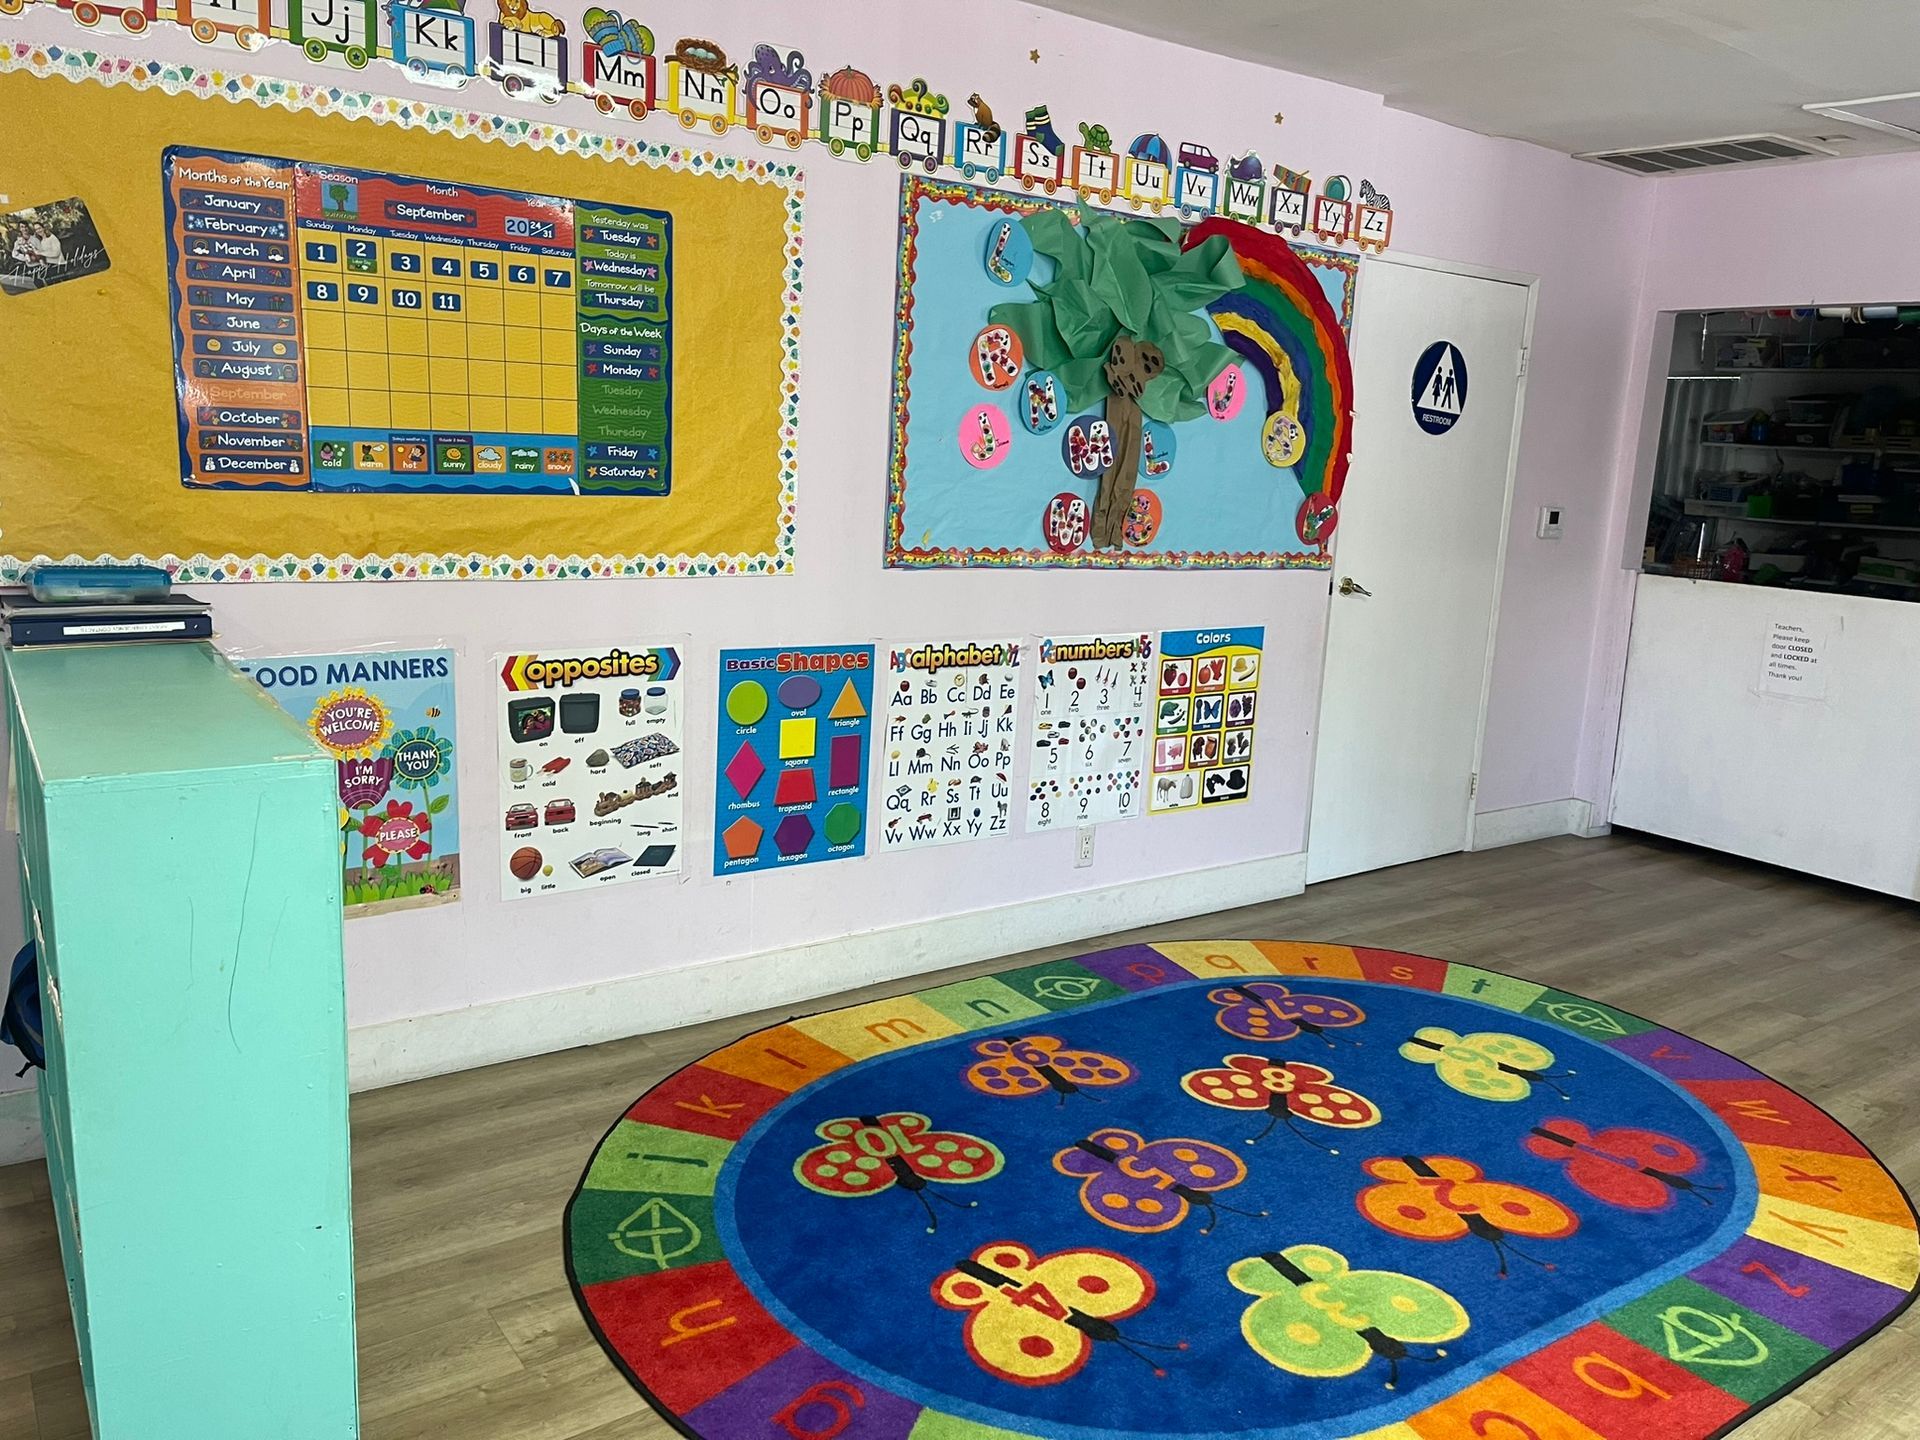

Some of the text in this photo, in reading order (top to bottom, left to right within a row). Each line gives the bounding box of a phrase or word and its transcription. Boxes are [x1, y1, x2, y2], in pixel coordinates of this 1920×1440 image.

[415, 13, 1384, 232] Kk Ll Mm Nn Oo Pp Qq Rr Ss Tt Uu Vv Ww Xx Yy Zz
[179, 167, 290, 191] Months of the Year
[318, 169, 358, 185] Season
[426, 184, 459, 197] Month
[204, 194, 262, 214] January
[396, 204, 465, 223] September
[204, 217, 268, 238] February
[506, 219, 528, 234] 20
[591, 215, 631, 229] Yesterday
[305, 219, 572, 258] Sunday Monday Tuesday Wednesday Thursday Friday Saturday
[600, 230, 641, 246] Tuesday
[215, 241, 259, 257] March
[605, 249, 628, 260] Today
[317, 242, 563, 286] 1 2 3 4 5 6 7
[593, 260, 648, 278] Wednesday
[221, 265, 256, 282] April
[585, 279, 628, 290] Tomorrow
[629, 284, 643, 292] will
[226, 292, 255, 308] May
[316, 285, 455, 309] 8 9 10 11
[596, 293, 644, 309] Thursday
[226, 316, 261, 329] June
[580, 322, 663, 339] Days of the Week
[232, 340, 261, 356] July
[603, 344, 642, 358] Sunday
[221, 362, 273, 379] August
[602, 364, 643, 378] Monday
[209, 386, 288, 400] September
[601, 385, 644, 399] Tuesday
[219, 411, 280, 425] October
[592, 405, 652, 418] Wednesday
[1422, 413, 1452, 426] RESTROOM
[598, 425, 647, 439] Thursday
[217, 433, 286, 447] November
[607, 445, 638, 459] Friday
[217, 457, 288, 470] December
[322, 458, 342, 468] cold
[403, 461, 417, 469] hot
[443, 462, 466, 470] sunny
[477, 461, 502, 470] cloudy
[514, 462, 535, 472] rainy
[547, 463, 572, 472] snowy
[599, 466, 646, 479] Saturday
[1775, 623, 1804, 633] Teachers,
[1196, 632, 1231, 644] Colors
[1773, 633, 1810, 644] Please keep
[1056, 638, 1134, 662] numbers
[1788, 645, 1813, 653] CLOSED
[726, 651, 869, 673] Basic Shapes
[911, 643, 1001, 674] alphabet
[1783, 654, 1809, 662] LOCKED
[326, 657, 449, 684] MANNERS
[526, 650, 659, 687] opposites
[1768, 671, 1786, 679] Thank
[891, 684, 1015, 706] Aa Bb Cc Dd Ee
[327, 707, 373, 721] YOU'RE
[791, 709, 806, 717] oval
[319, 720, 381, 737] WELCOME
[834, 718, 860, 728] triangle
[735, 726, 757, 735] circle
[911, 724, 932, 743] Gg
[397, 749, 437, 762] THANK
[1049, 748, 1058, 763] 5
[406, 759, 430, 771] YOU
[785, 758, 809, 768] square
[908, 760, 933, 775] Mm
[355, 766, 373, 775] I'M
[344, 776, 383, 788] SORRY
[542, 780, 556, 788] cold
[828, 786, 859, 796] rectangle
[728, 800, 760, 810] rhombus
[886, 795, 911, 812] Qq
[1119, 792, 1130, 808] 10
[778, 803, 813, 813] trapezoid
[589, 817, 622, 826] beginning
[379, 828, 417, 842] PLEASE
[909, 825, 937, 841] Ww
[827, 844, 855, 854] octagon
[724, 856, 759, 868] pentagon
[777, 852, 808, 862] hexagon
[600, 874, 616, 882] open
[631, 868, 651, 877] closed
[520, 886, 532, 894] big
[966, 999, 1011, 1017] n
[865, 1016, 927, 1044] m
[674, 1093, 746, 1119] k
[853, 1124, 924, 1157] 10
[1118, 1155, 1176, 1190] 5
[1779, 1163, 1843, 1192] x
[1000, 1282, 1068, 1321] 4
[1302, 1283, 1371, 1328] 3
[660, 1299, 738, 1347] h
